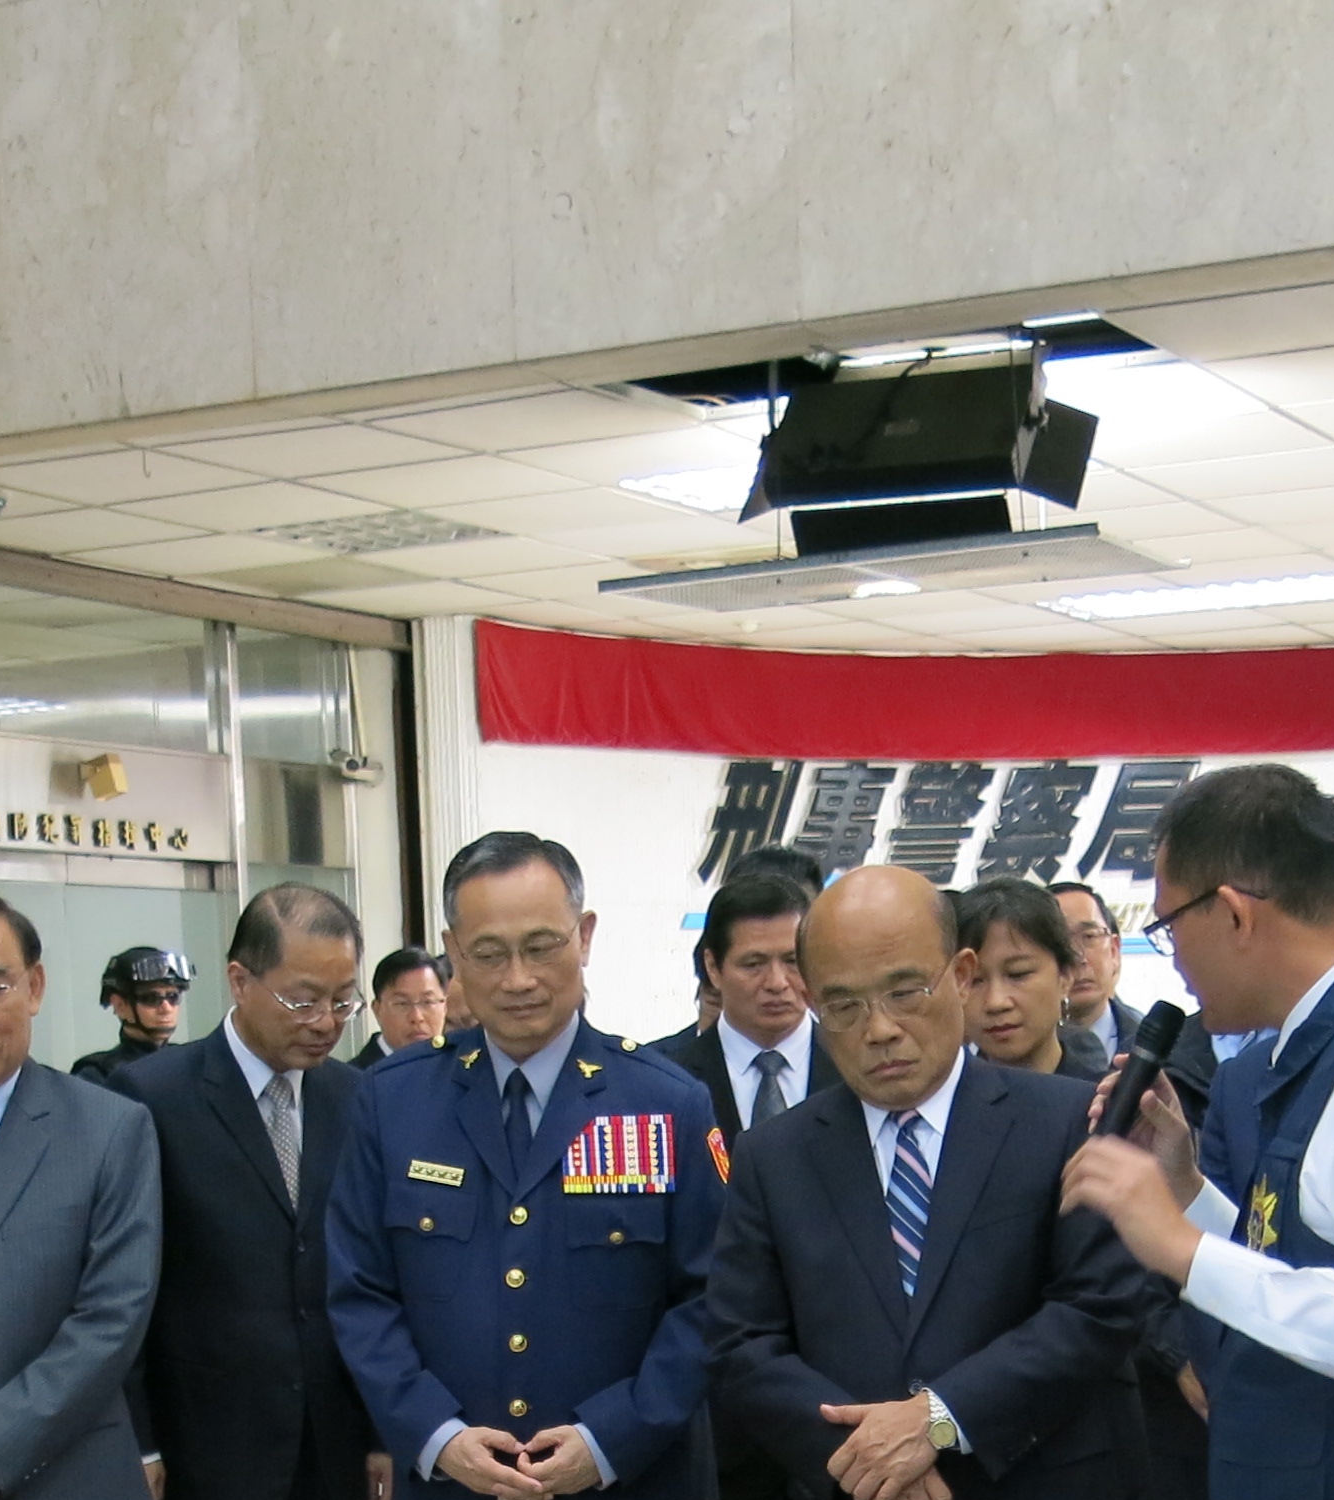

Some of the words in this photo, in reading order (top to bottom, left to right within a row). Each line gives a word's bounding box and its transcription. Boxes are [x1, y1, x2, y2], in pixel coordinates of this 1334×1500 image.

[697, 760, 1201, 885] 刑事警察局
